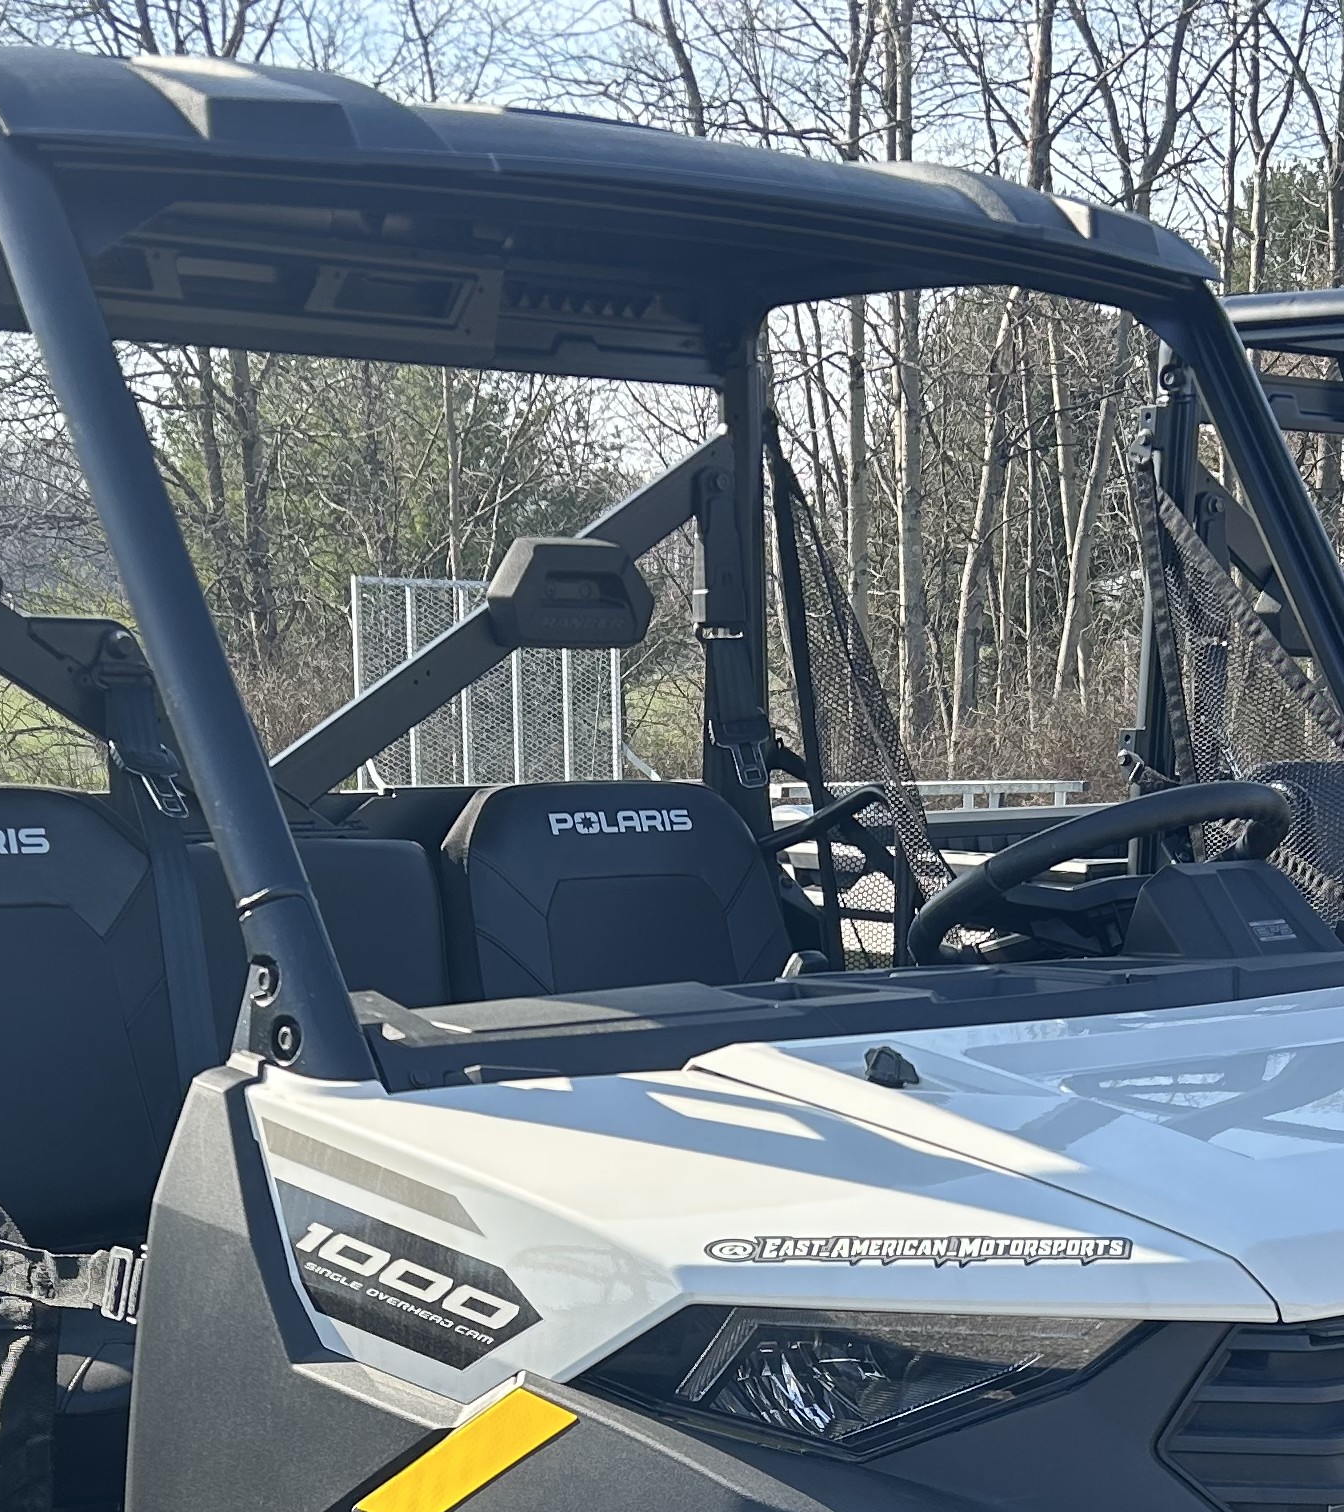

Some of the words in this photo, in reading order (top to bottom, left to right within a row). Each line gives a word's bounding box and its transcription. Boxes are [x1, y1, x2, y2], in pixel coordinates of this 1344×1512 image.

[548, 809, 693, 836] POLARIS
[295, 1221, 520, 1330] 1000
[303, 1261, 364, 1291] SINGLE
[366, 1286, 454, 1329] OVERHEAD
[454, 1323, 495, 1345] CAM
